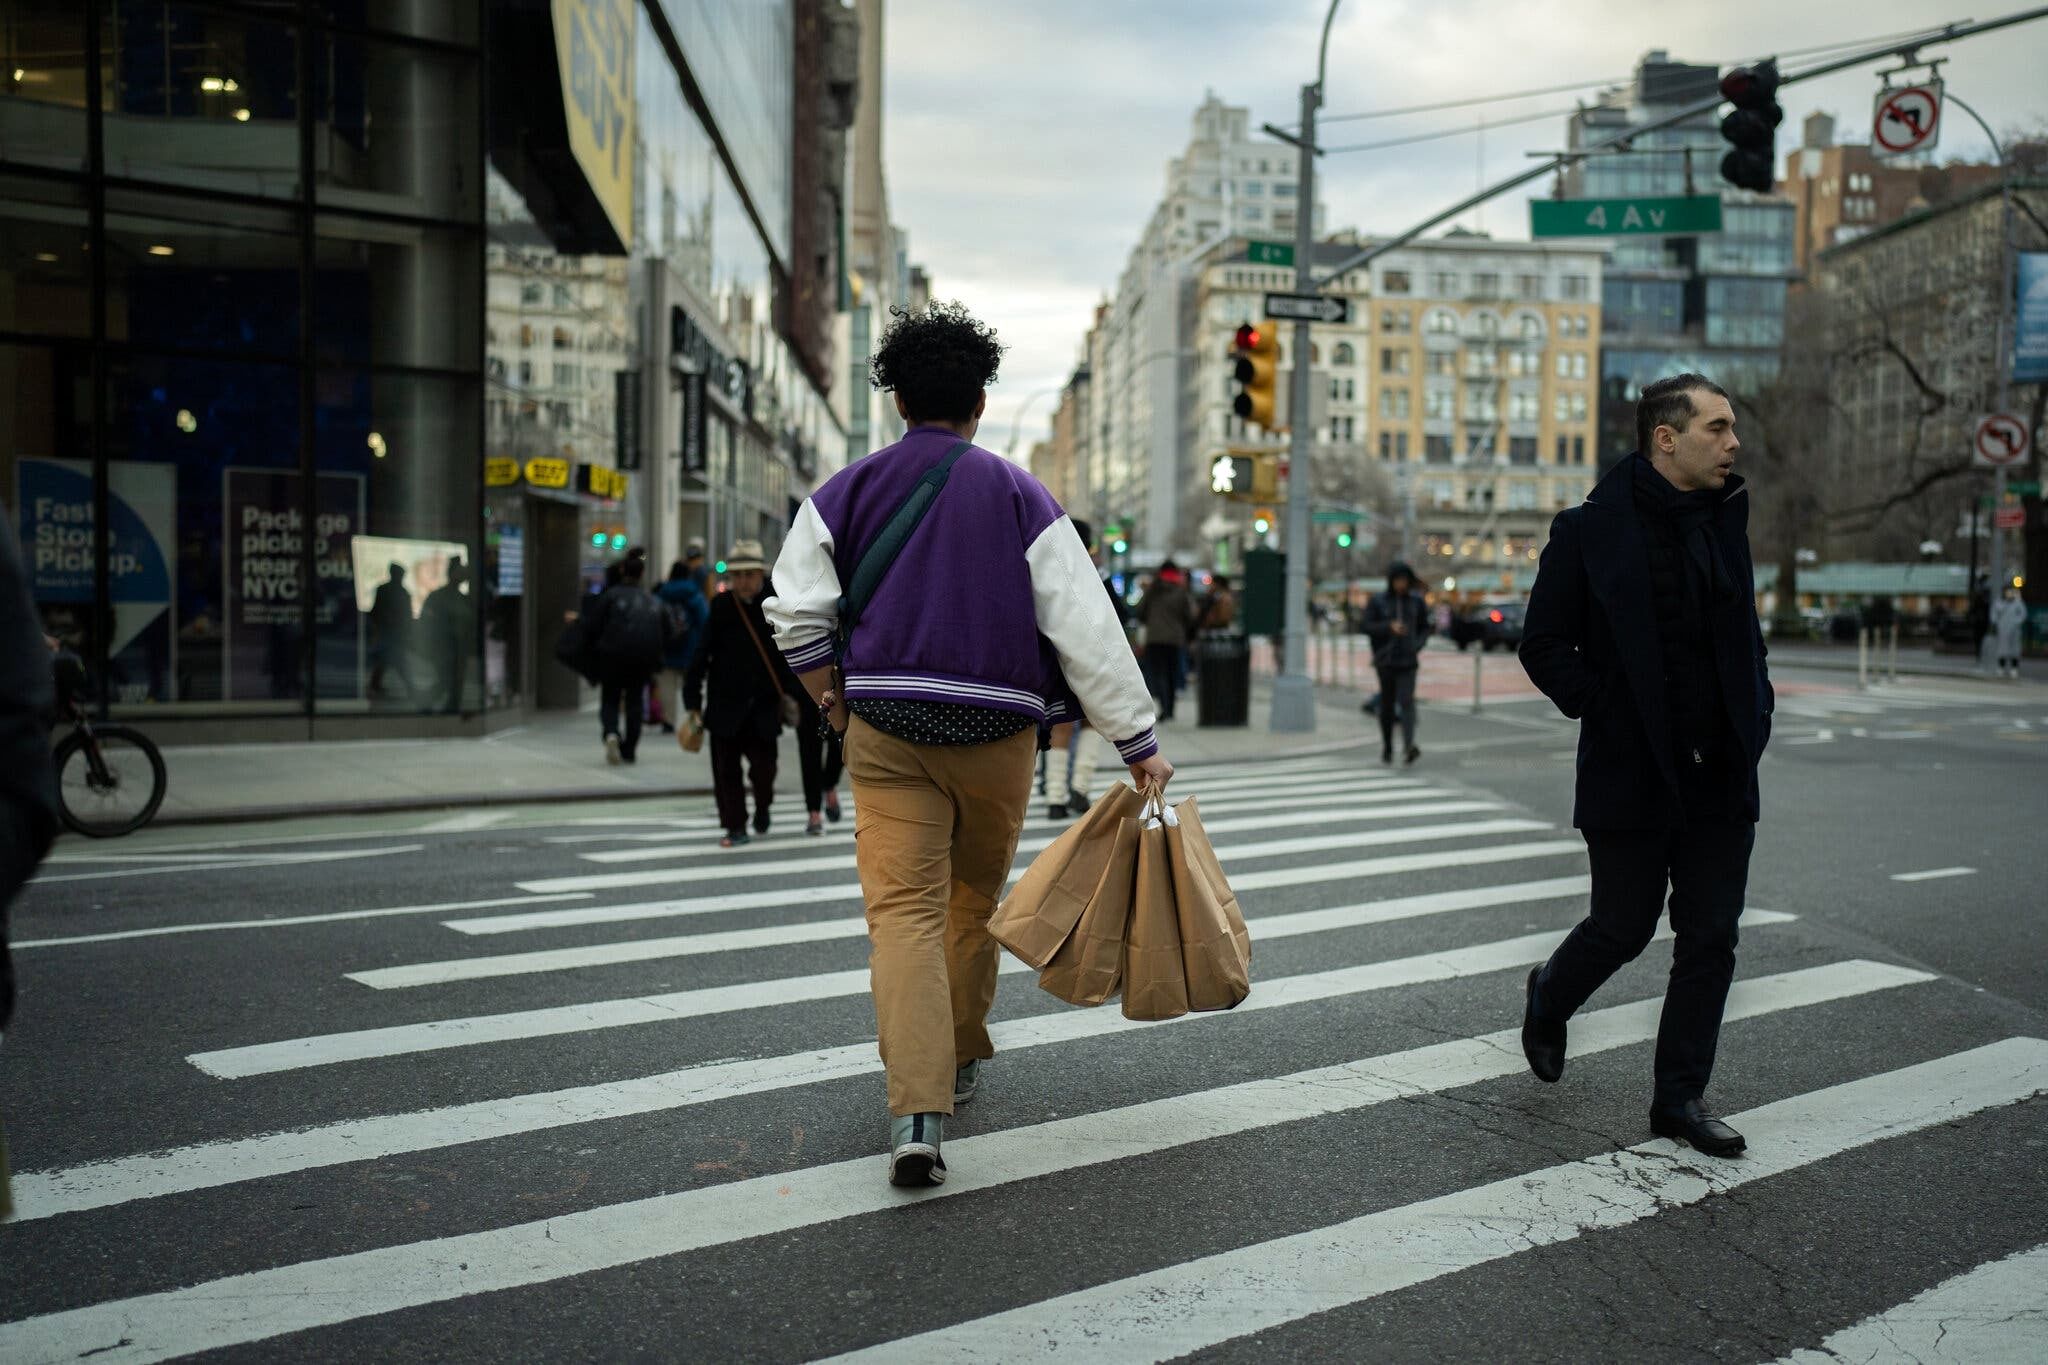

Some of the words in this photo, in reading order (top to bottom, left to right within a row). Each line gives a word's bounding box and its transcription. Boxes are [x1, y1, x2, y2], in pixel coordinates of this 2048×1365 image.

[570, 6, 627, 181] BUY
[1586, 204, 1608, 229] 4
[242, 505, 351, 537] Packge
[242, 558, 301, 577] near
[316, 558, 354, 581] ou,
[242, 576, 300, 600] NYC
